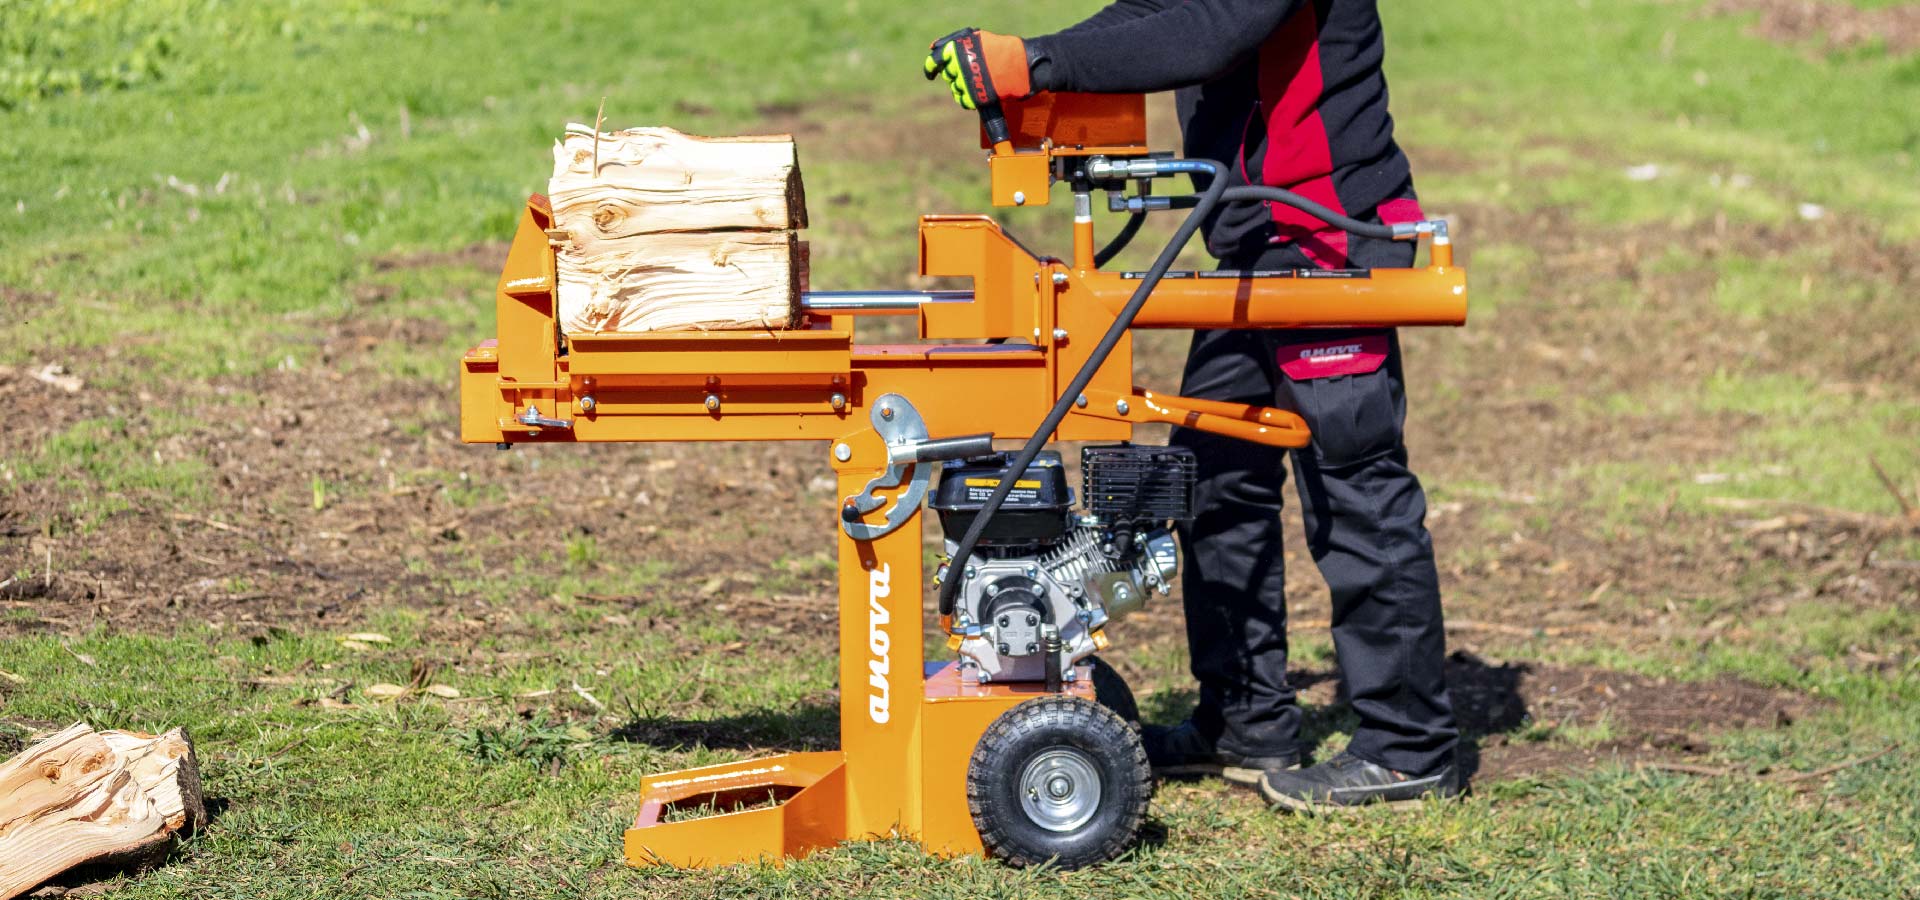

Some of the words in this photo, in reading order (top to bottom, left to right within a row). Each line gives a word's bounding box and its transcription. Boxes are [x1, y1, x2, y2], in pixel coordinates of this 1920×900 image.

[958, 36, 988, 103] anova
[1300, 344, 1361, 359] anova
[869, 562, 890, 724] anova
